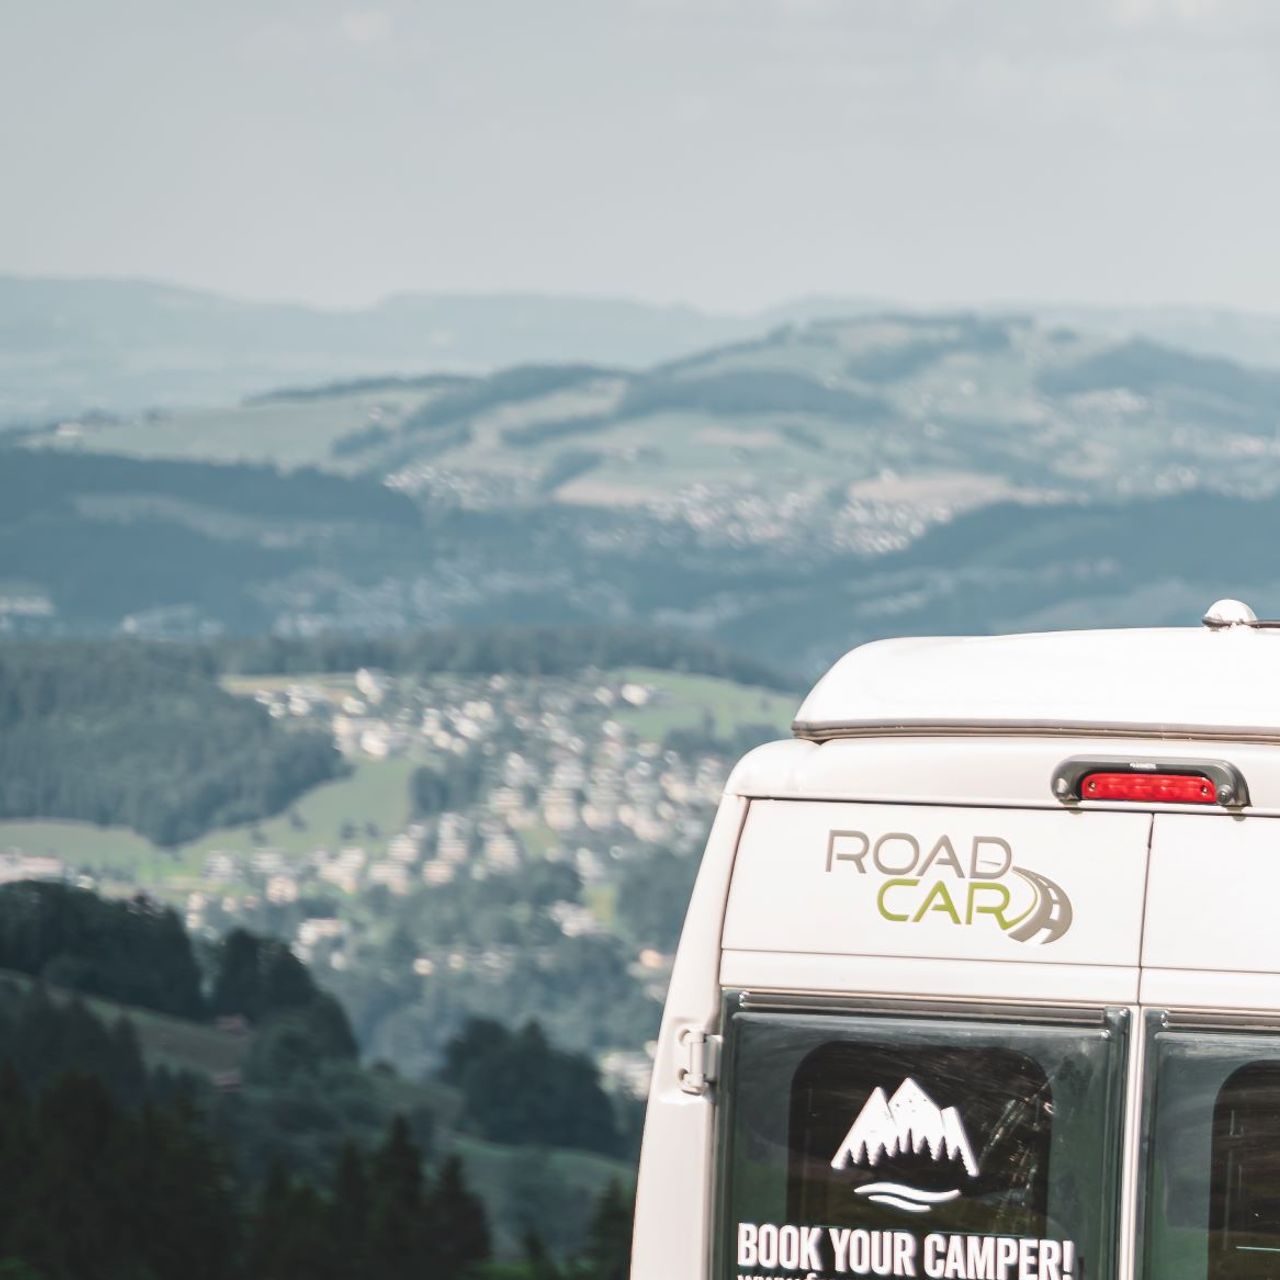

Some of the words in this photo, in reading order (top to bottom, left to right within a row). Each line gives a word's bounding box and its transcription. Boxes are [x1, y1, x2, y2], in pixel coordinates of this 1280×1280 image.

[825, 829, 1012, 880] ROAD
[876, 878, 1014, 931] CAR
[737, 1222, 823, 1271] BOOK
[828, 1227, 918, 1278] YOUR
